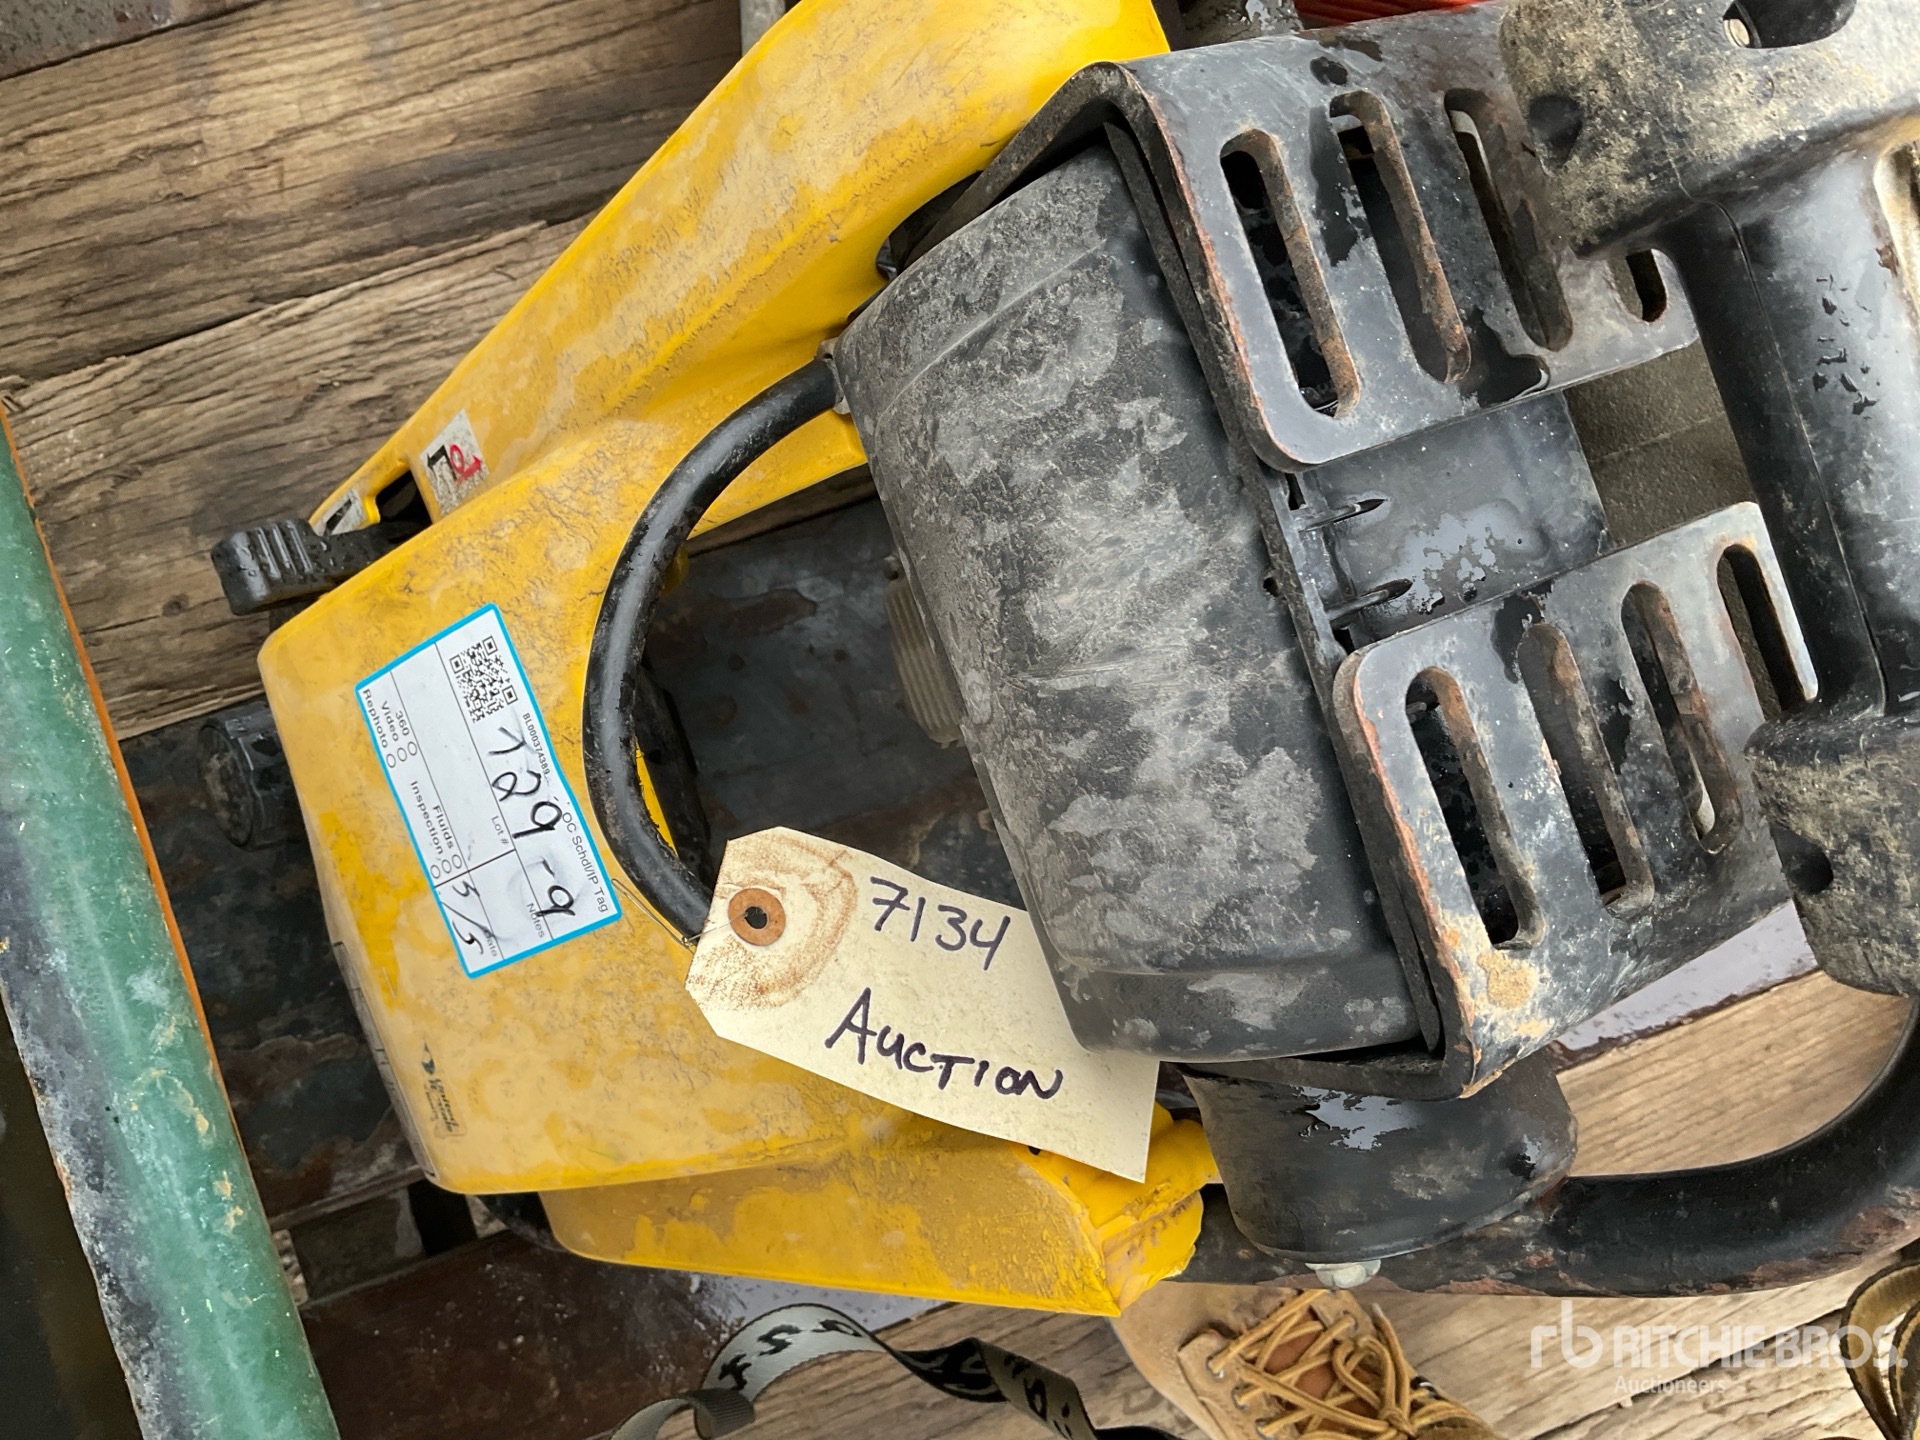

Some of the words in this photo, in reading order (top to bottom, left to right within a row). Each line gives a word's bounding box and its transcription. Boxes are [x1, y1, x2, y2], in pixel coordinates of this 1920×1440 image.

[362, 688, 388, 748] Rephoto
[381, 701, 399, 742] Video
[395, 710, 410, 736] 360
[522, 712, 551, 776] BL000374389
[410, 780, 443, 855] Inspection
[432, 805, 454, 849] Fluids
[491, 815, 505, 836] Lot
[560, 811, 577, 833] OC
[572, 835, 599, 885] Schdl/IP
[593, 886, 609, 913] Tag
[526, 903, 545, 938] Notes
[869, 875, 1012, 971] 7134
